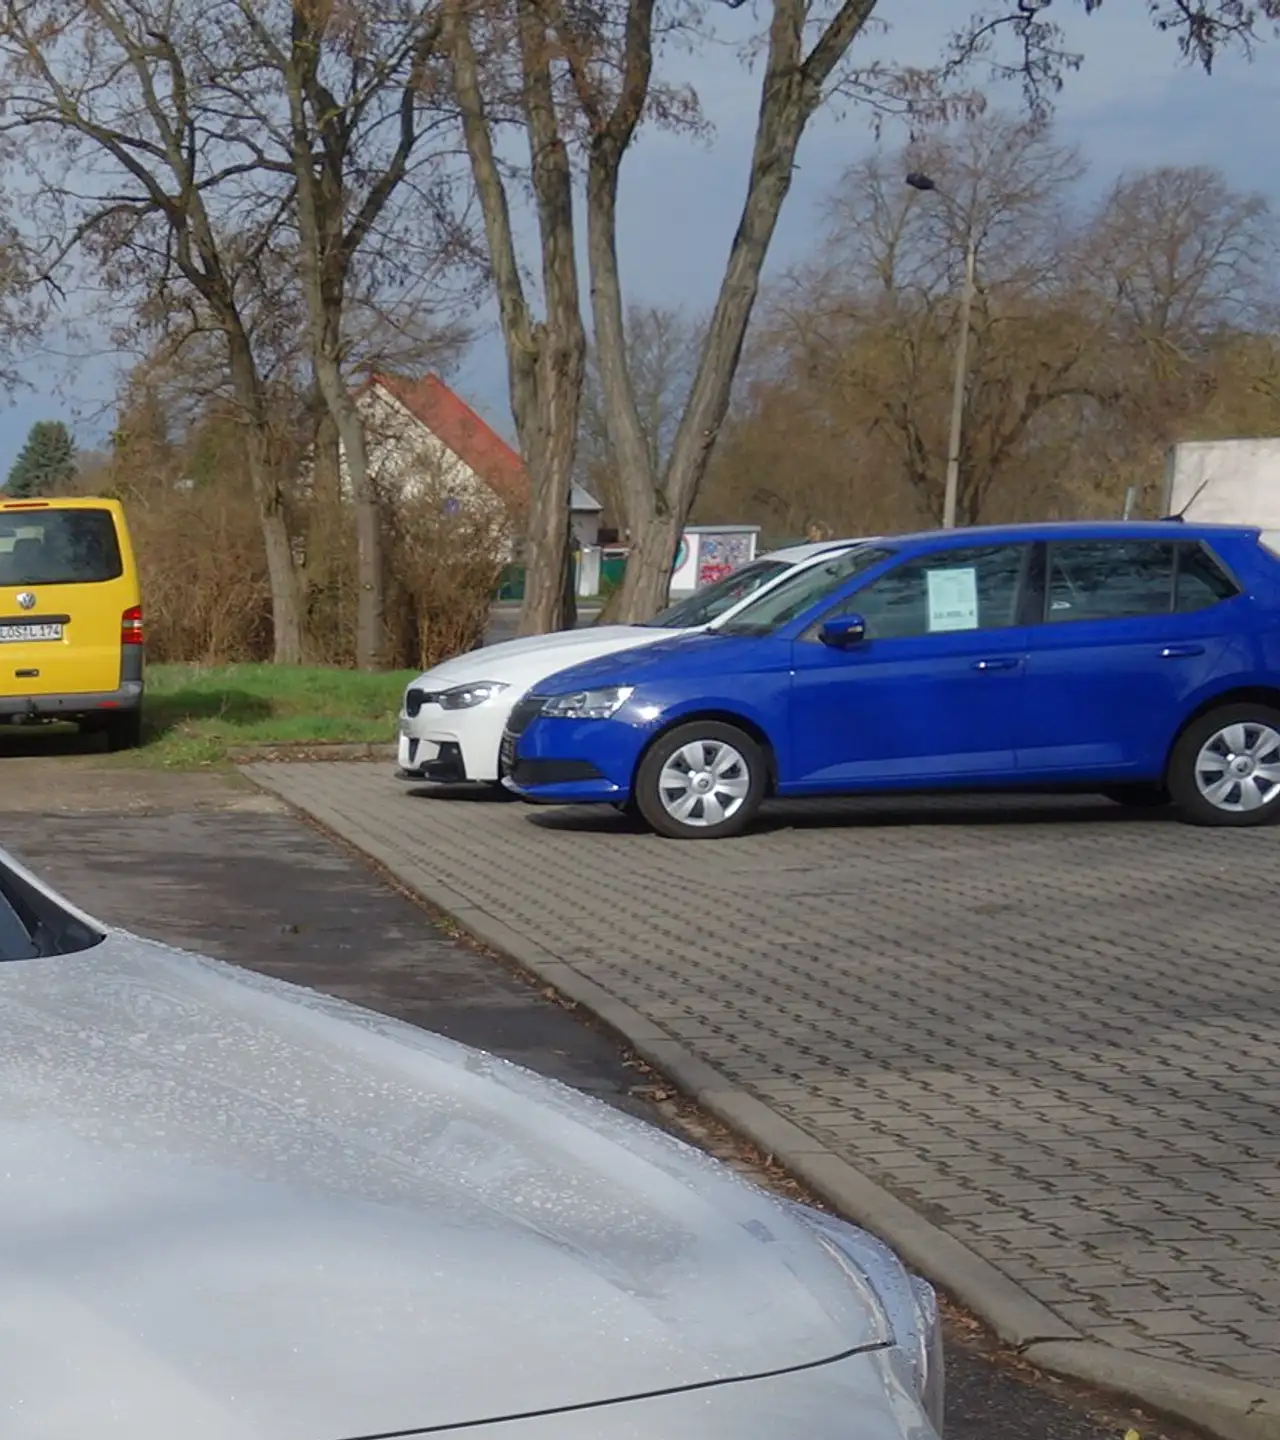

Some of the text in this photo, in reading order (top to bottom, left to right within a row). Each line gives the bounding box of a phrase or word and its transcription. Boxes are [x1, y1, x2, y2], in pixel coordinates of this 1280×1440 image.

[0, 624, 60, 638] LOS L 174
